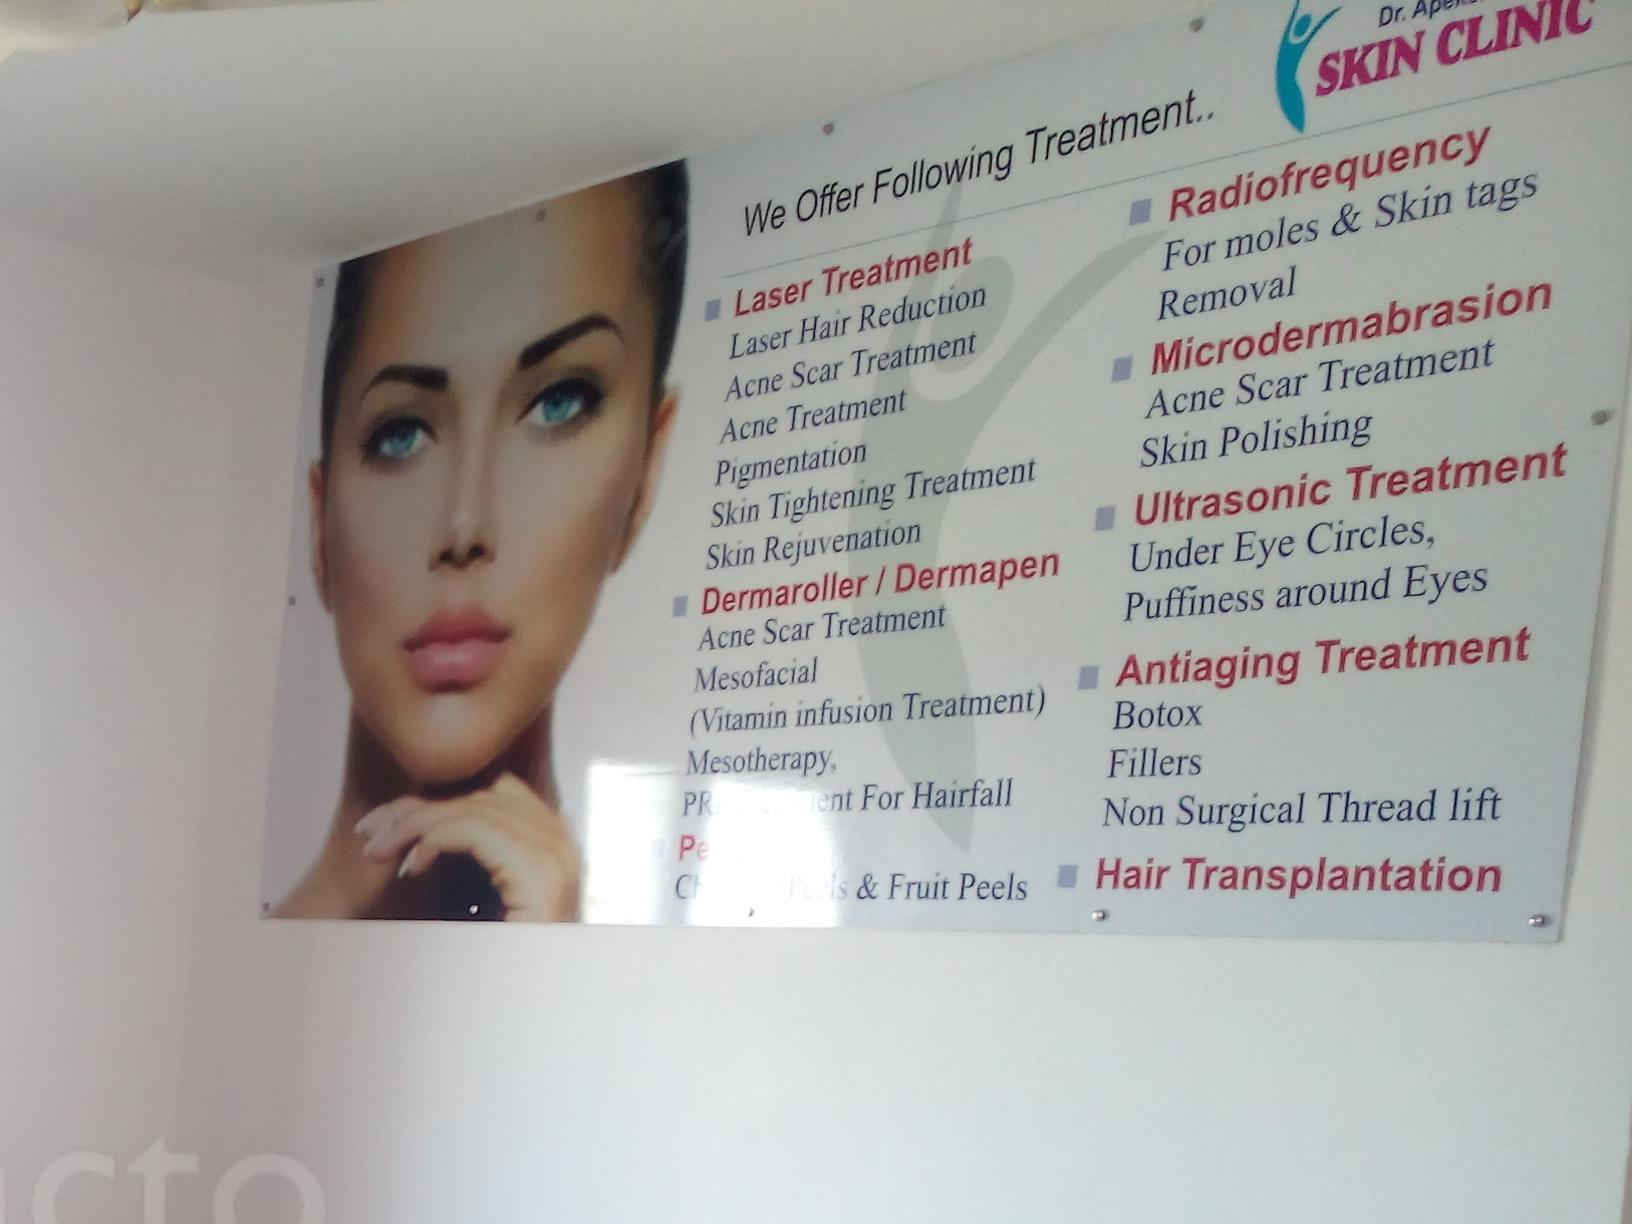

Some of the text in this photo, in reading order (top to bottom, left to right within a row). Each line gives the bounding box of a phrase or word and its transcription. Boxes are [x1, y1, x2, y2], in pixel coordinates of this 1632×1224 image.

[1378, 7, 1406, 27] Dr.
[1316, 0, 1594, 97] SKIN CLINIC
[744, 200, 786, 236] We
[796, 183, 864, 222] Offer
[873, 143, 1014, 199] Following
[1168, 126, 1491, 222] Radiofrequency
[1163, 172, 1538, 271] For moles & Skin tags
[733, 238, 973, 317] Laser Treatment
[1157, 264, 1297, 321] Removal
[729, 285, 986, 360] Laser Hair Reduction
[1151, 281, 1553, 375] Microdermabrasion
[724, 330, 977, 401] Acne Scar Treatment
[1145, 337, 1495, 419] Acne Scar Treatment
[719, 389, 907, 444] Acne Treatment
[1140, 410, 1373, 468] Skin Polishing
[710, 458, 1036, 529] Skin Tightening Treatment
[714, 441, 867, 490] Pigmentation
[1135, 442, 1568, 526] Ultrasonic Treatment
[706, 520, 921, 571] Skin Rejuvenation
[1130, 514, 1435, 572] Under Eye Circles,
[701, 551, 1060, 615] Dermaroller / Dermapen
[1123, 562, 1488, 623] Puffiness around Eyes
[698, 603, 947, 652] Acne Scar Treatment
[693, 657, 818, 693] Mesofacial
[1115, 626, 1532, 689] Antiaging Treatment
[690, 683, 1046, 738] (Vitamin infusion Treatment)
[1112, 700, 1203, 730] Botox
[686, 746, 837, 779] Mesotherapy,
[1107, 746, 1202, 779] Fillers
[681, 790, 724, 817] PR
[862, 784, 905, 813] For
[911, 777, 1013, 809] Hairfall
[1103, 787, 1502, 833] Non Surgical Thread lift
[856, 874, 878, 901] &
[888, 872, 949, 902] Fruit
[957, 871, 1028, 903] Peels
[1096, 856, 1502, 899] Hair Transplantation
